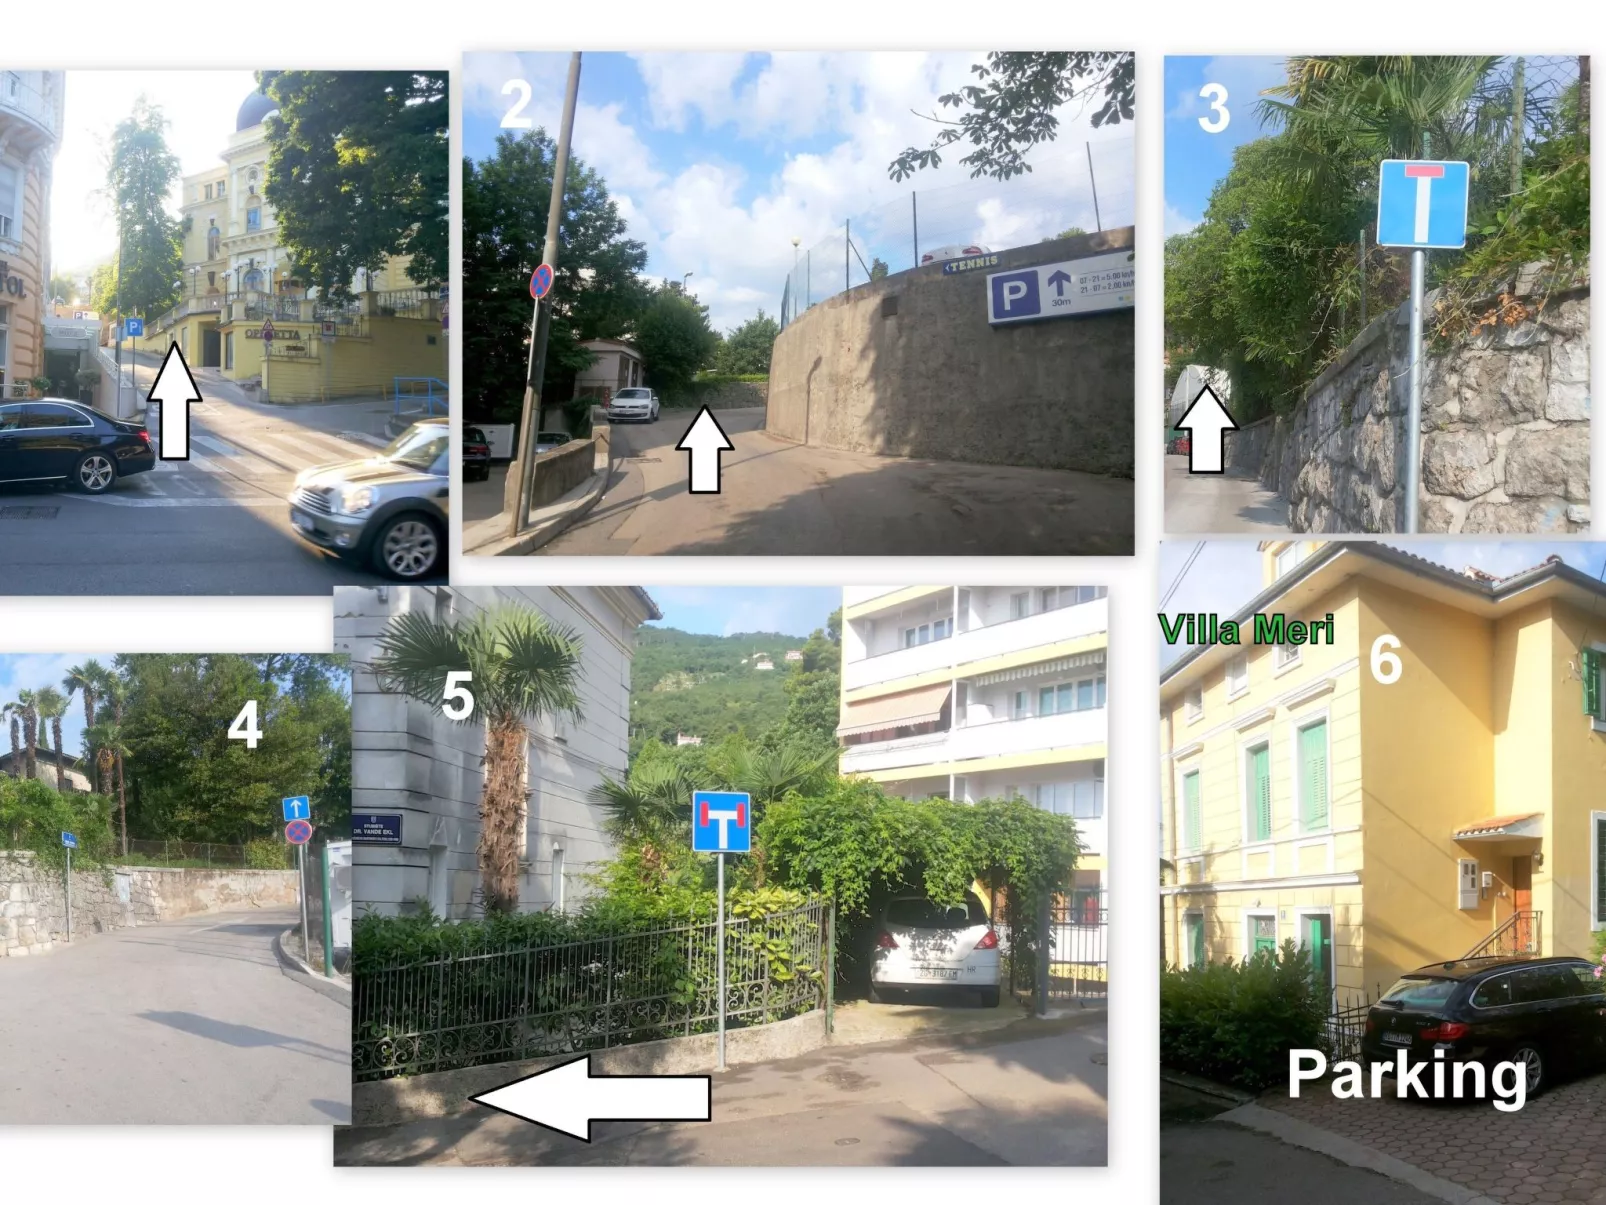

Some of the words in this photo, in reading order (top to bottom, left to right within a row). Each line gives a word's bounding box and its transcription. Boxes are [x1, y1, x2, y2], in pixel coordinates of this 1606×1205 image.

[951, 255, 998, 272] TENNIS
[1003, 280, 1028, 311] P
[1052, 298, 1071, 307] 30m
[130, 321, 138, 333] P
